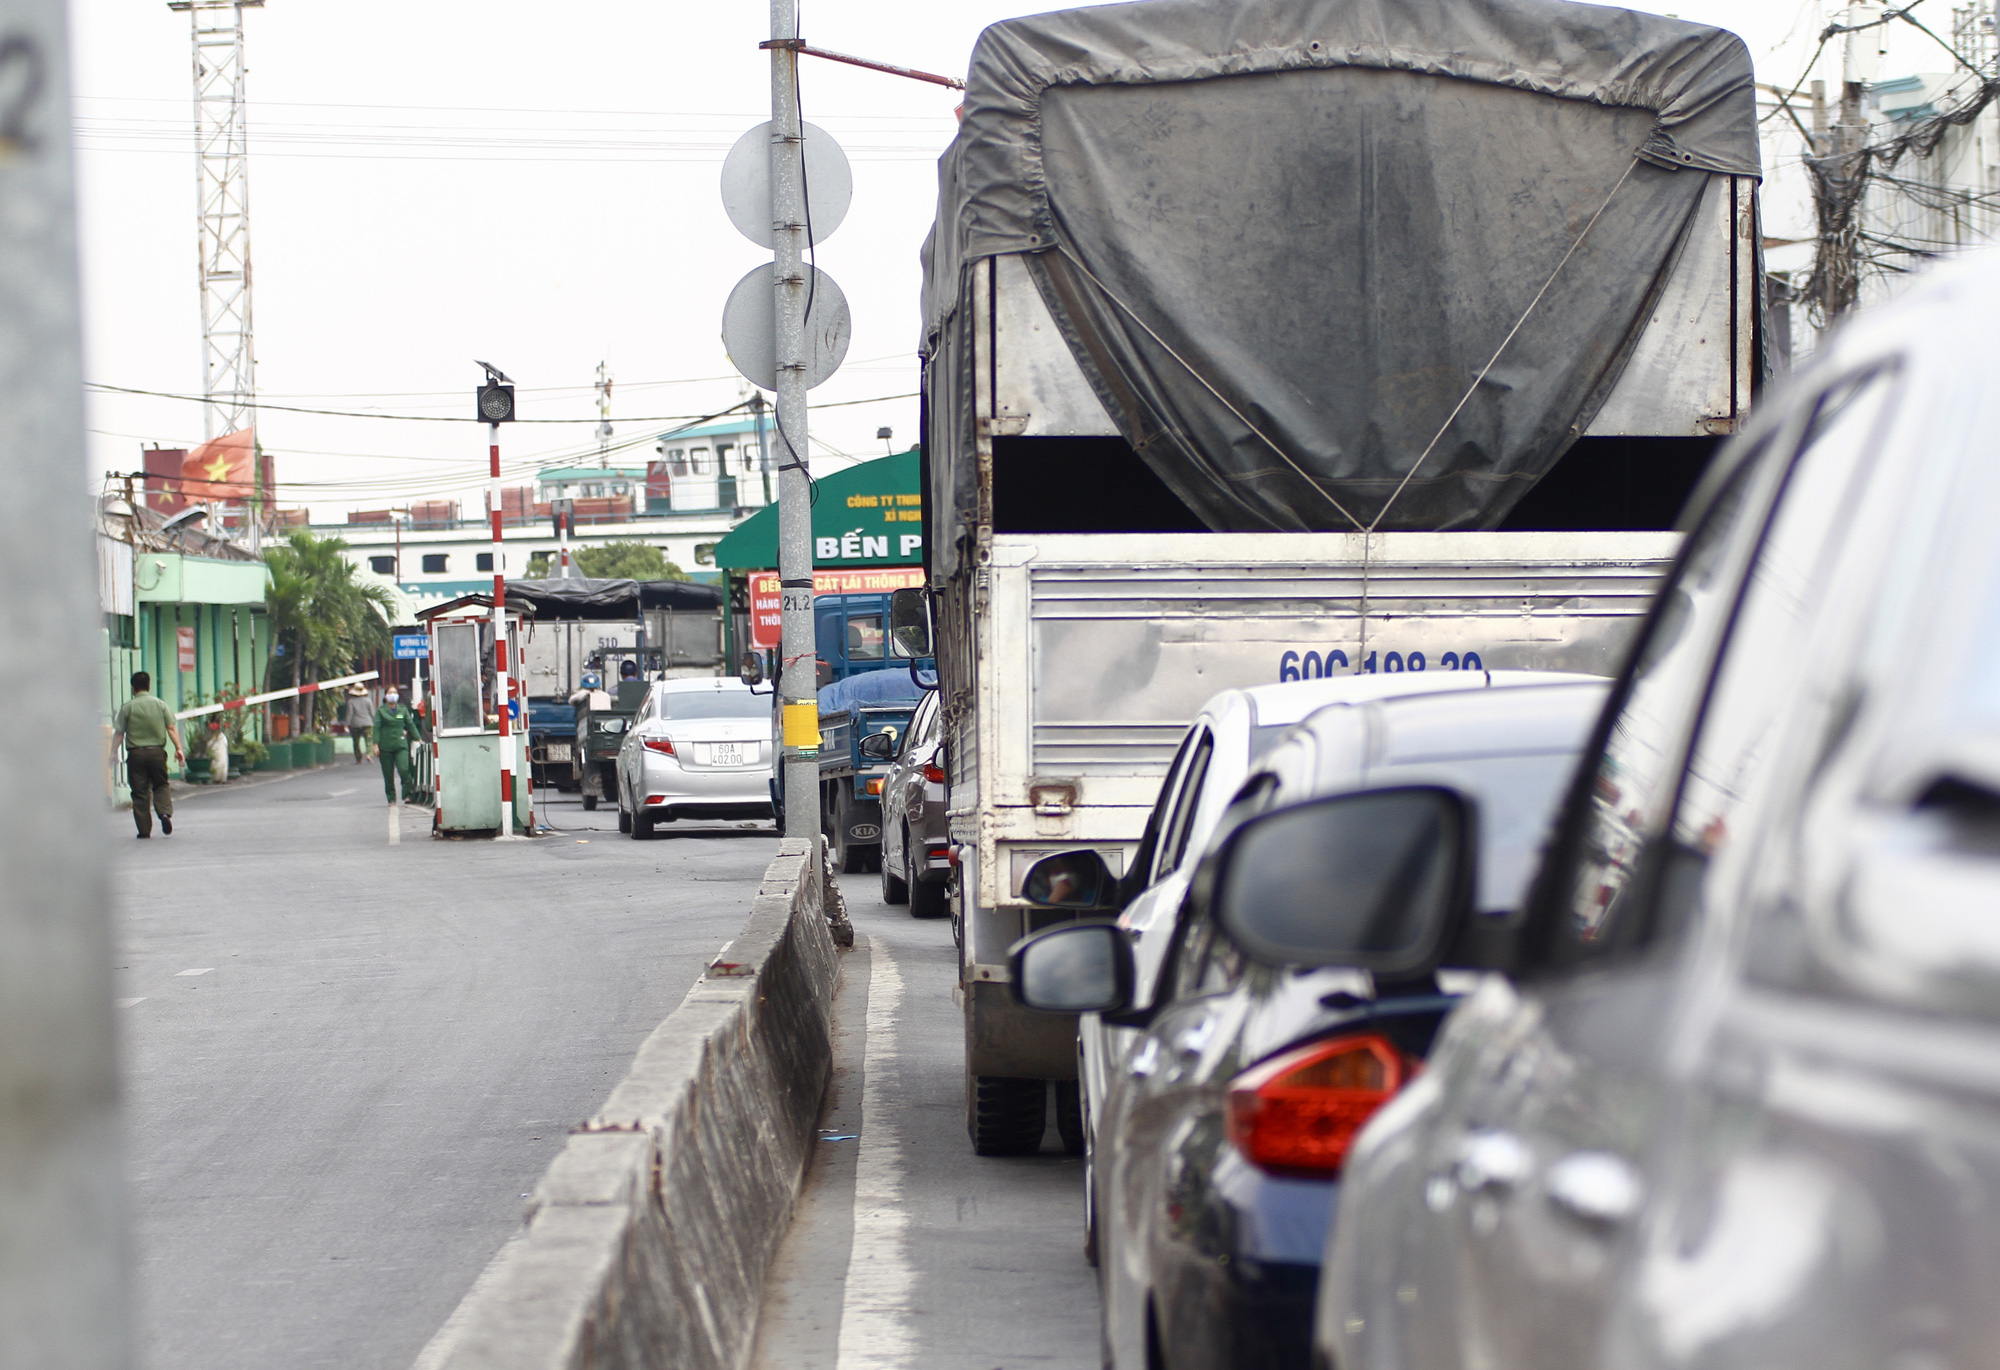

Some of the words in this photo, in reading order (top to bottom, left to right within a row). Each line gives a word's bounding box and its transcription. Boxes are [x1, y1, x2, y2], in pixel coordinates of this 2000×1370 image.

[816, 527, 889, 559] BẾN
[783, 594, 811, 612] 21.2
[718, 744, 736, 755] 60A
[855, 826, 876, 836] KIA
